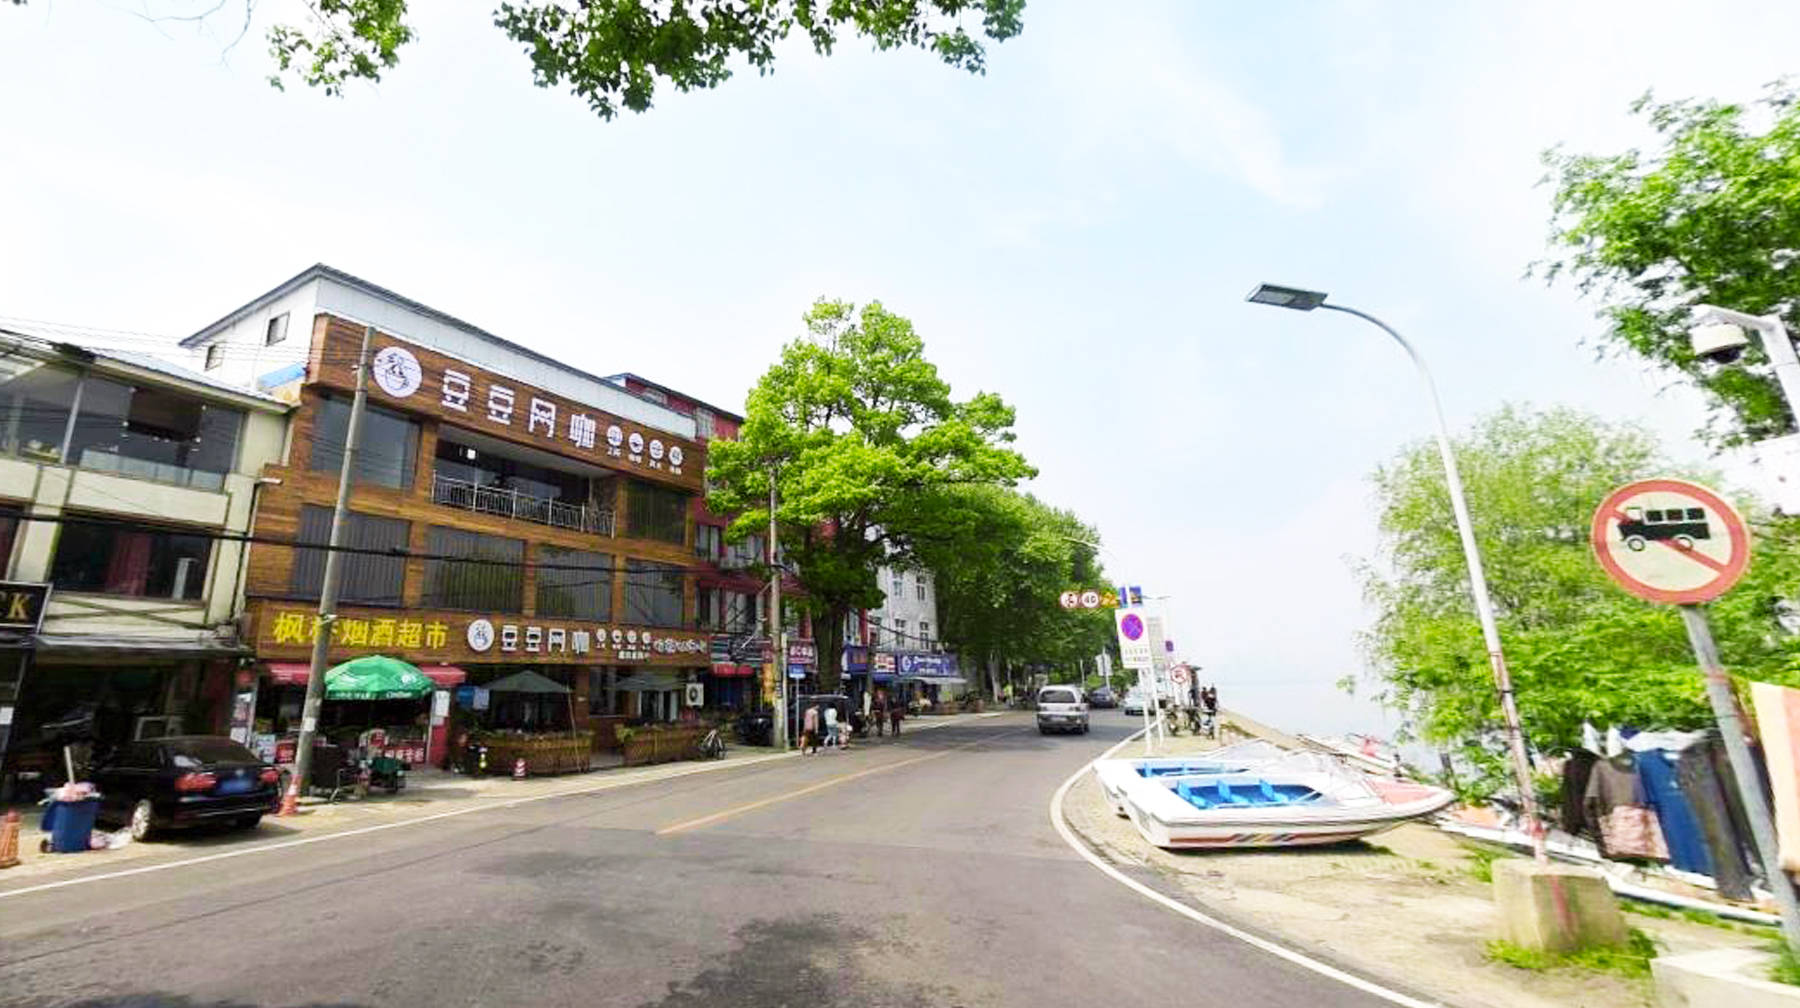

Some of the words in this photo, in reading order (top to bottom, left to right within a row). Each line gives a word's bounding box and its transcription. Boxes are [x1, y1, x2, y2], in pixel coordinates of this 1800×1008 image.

[441, 368, 596, 449] 豆豆网咖
[501, 624, 590, 655] 豆豆网咖
